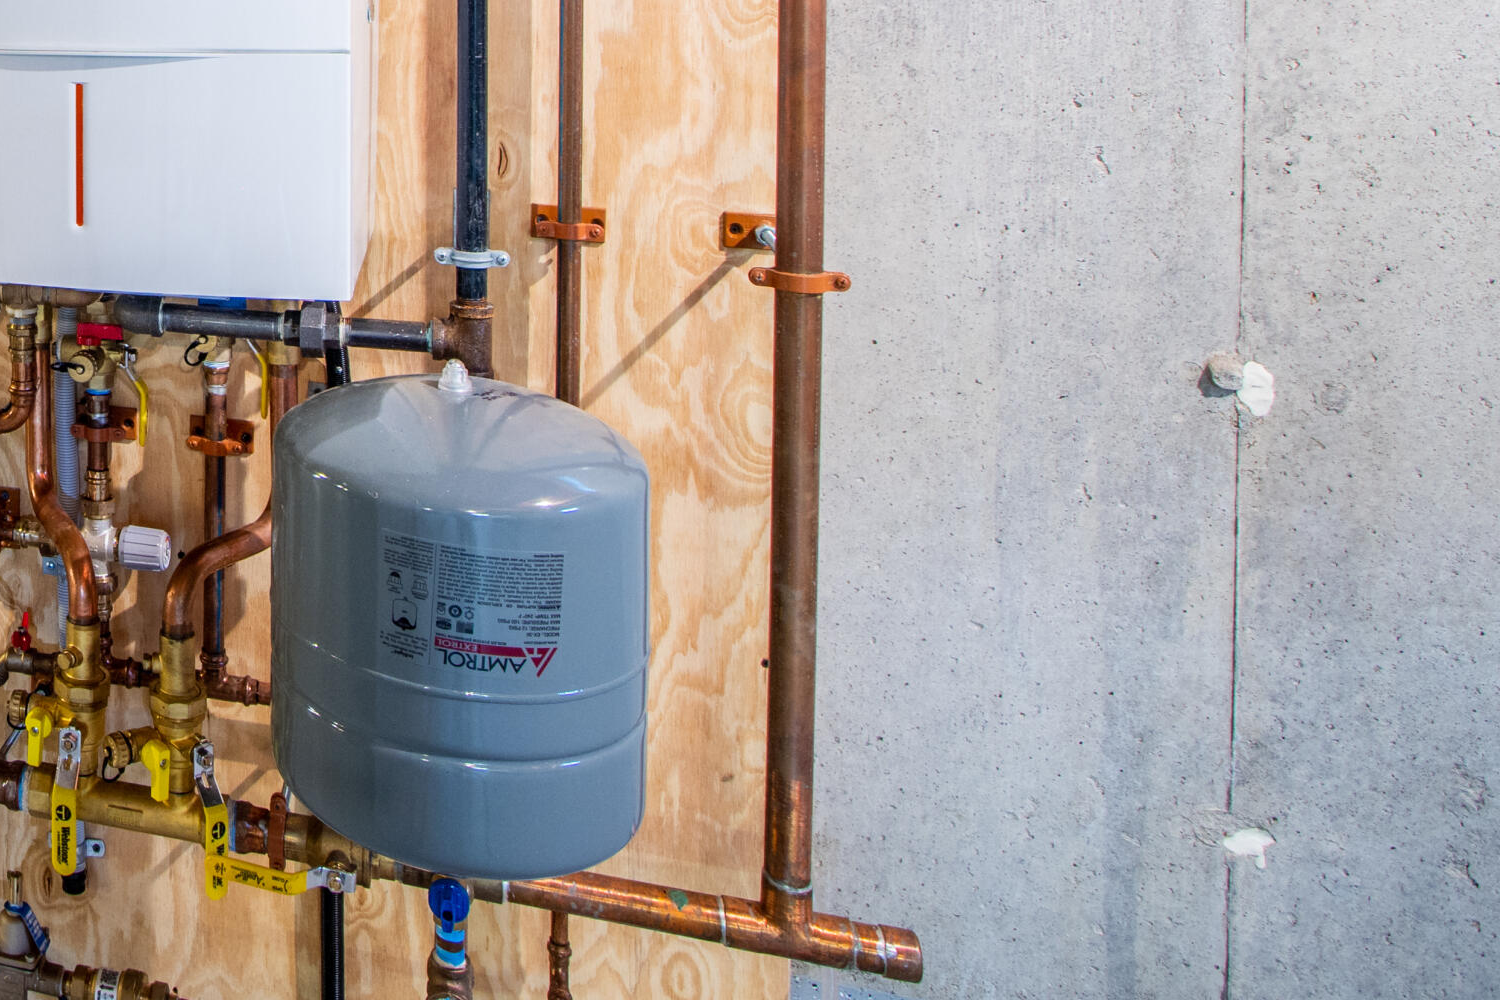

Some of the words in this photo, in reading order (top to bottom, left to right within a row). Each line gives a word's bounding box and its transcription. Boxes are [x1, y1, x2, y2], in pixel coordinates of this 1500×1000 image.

[436, 638, 478, 653] EXTROL
[435, 648, 527, 674] AMTROL
[62, 826, 70, 866] Webstone
